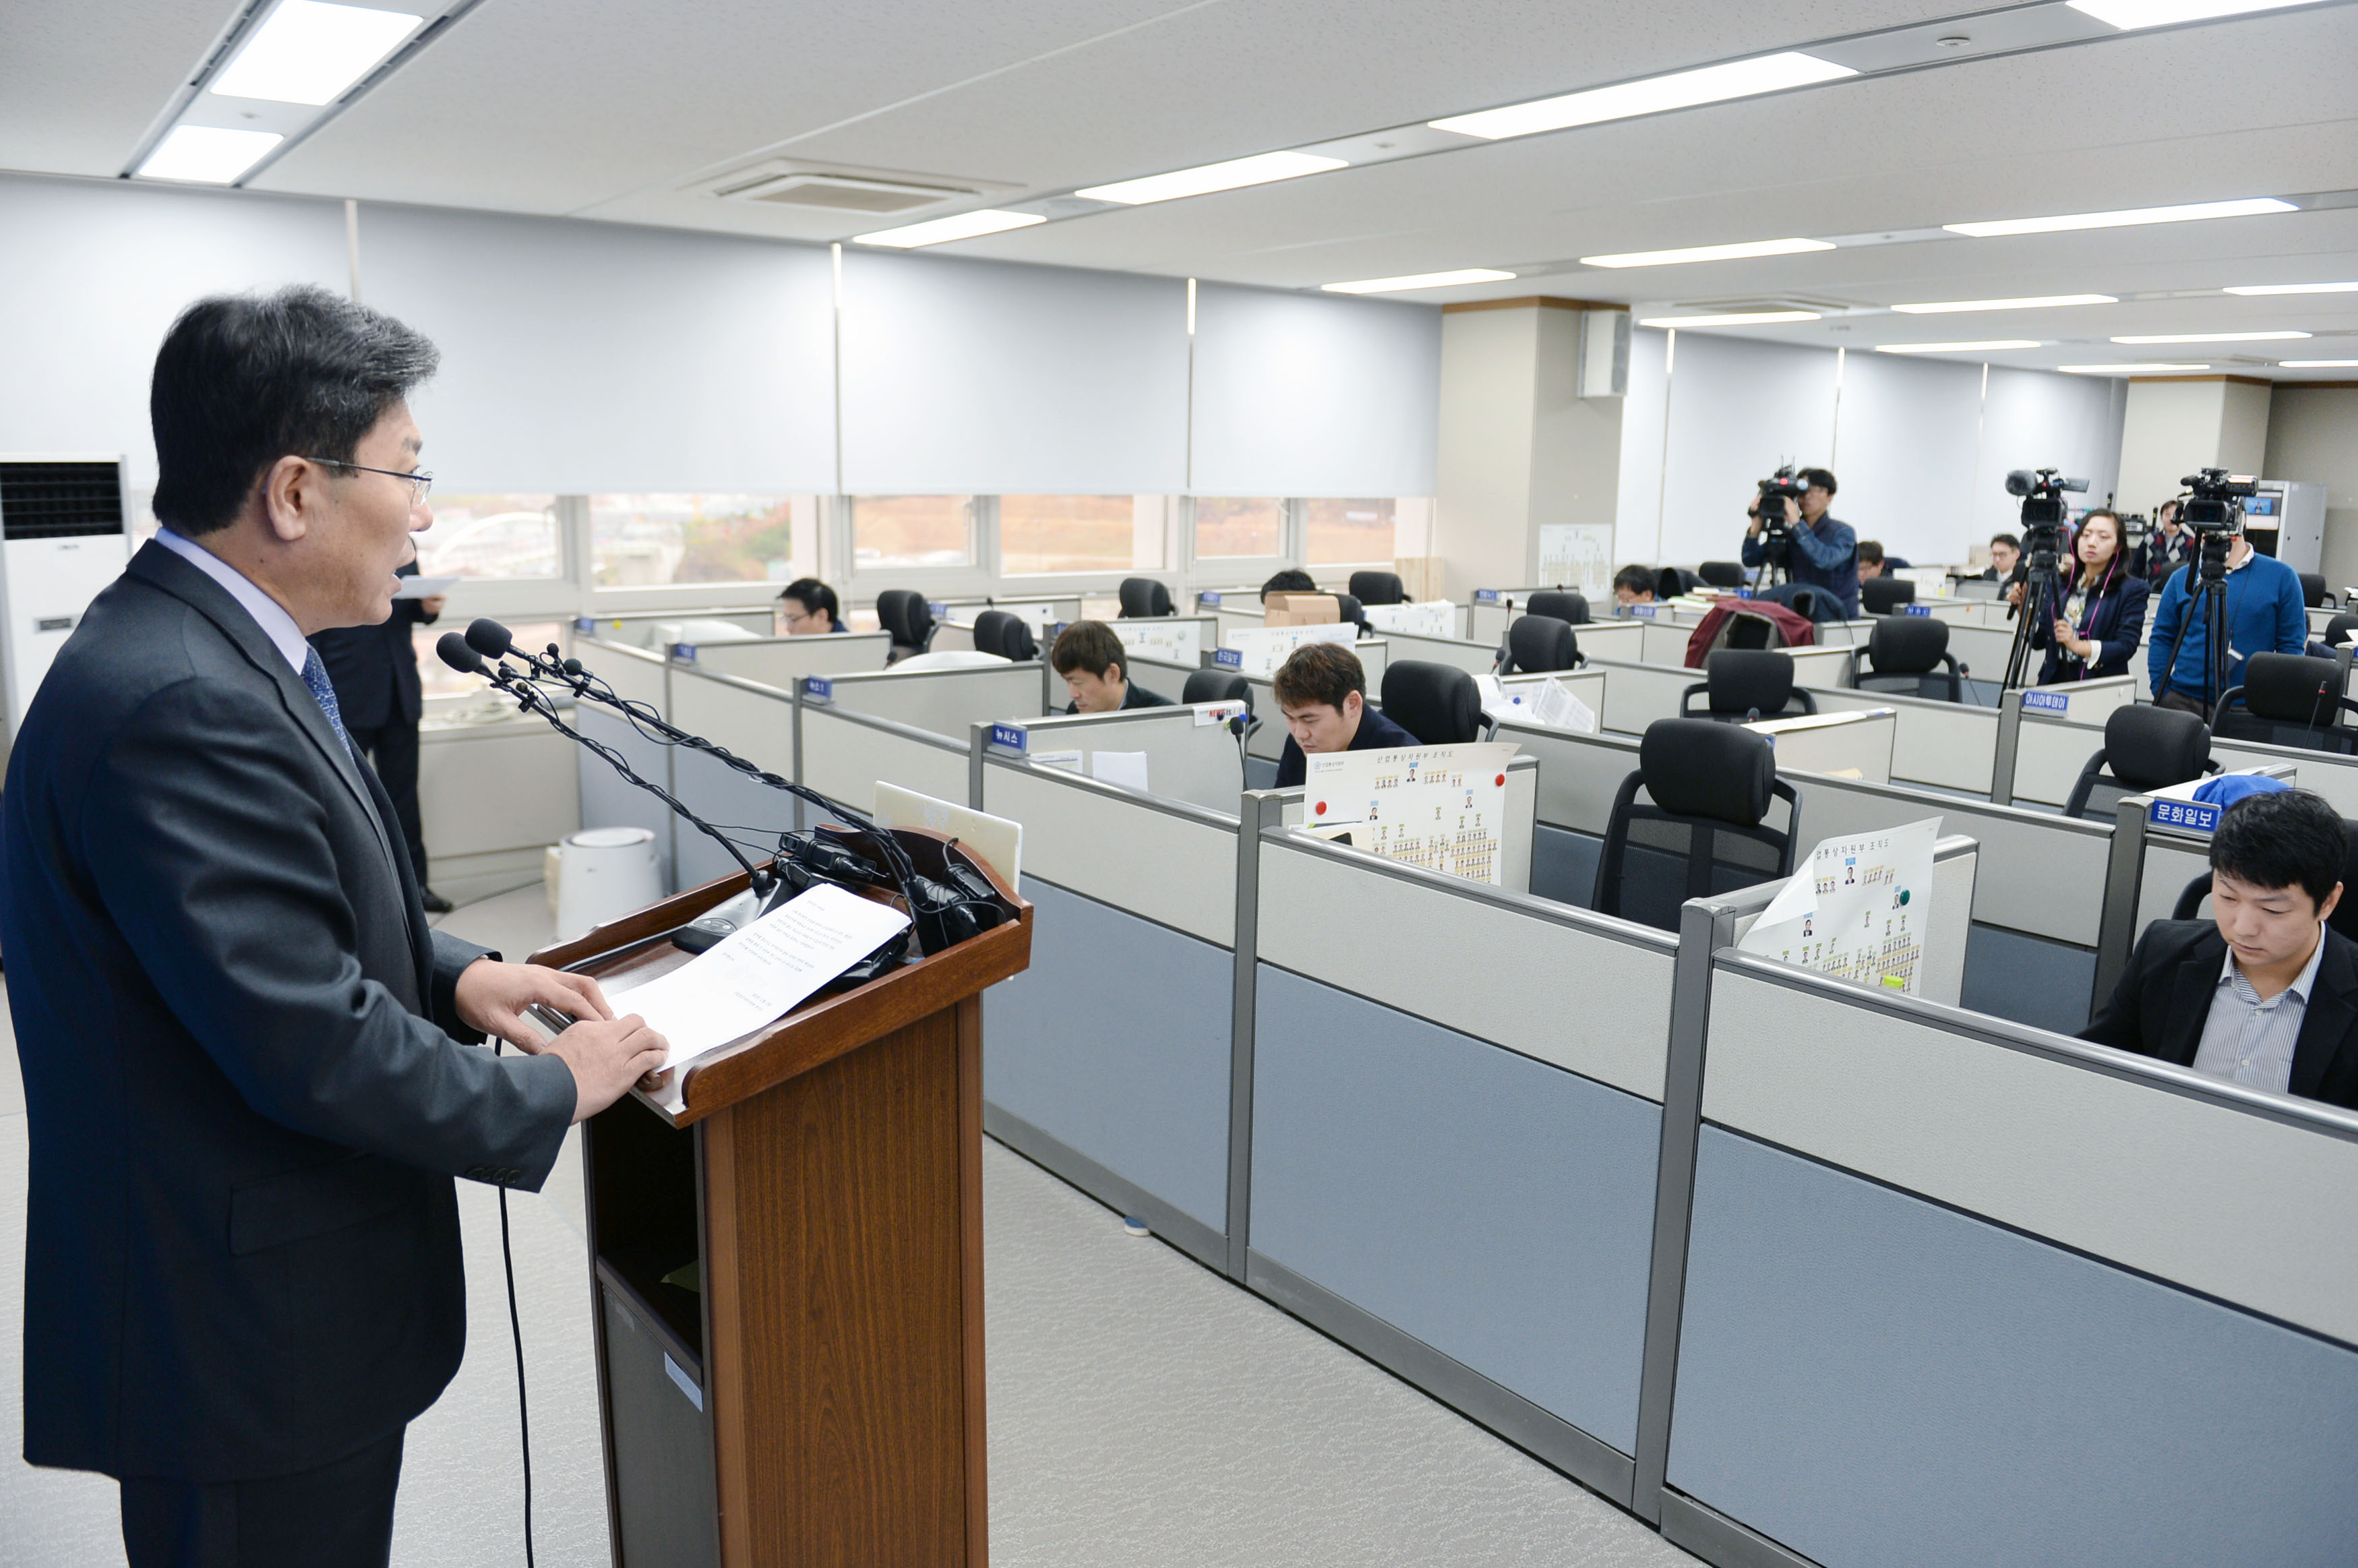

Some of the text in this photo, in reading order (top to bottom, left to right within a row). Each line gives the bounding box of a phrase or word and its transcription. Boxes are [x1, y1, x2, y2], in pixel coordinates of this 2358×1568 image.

[2026, 692, 2065, 709] 아시아투데이
[996, 729, 1018, 744] 뉴시스
[1377, 752, 1428, 764] 산업통상자원부
[2157, 804, 2212, 828] 문화일보
[1869, 838, 1889, 851] 조직도
